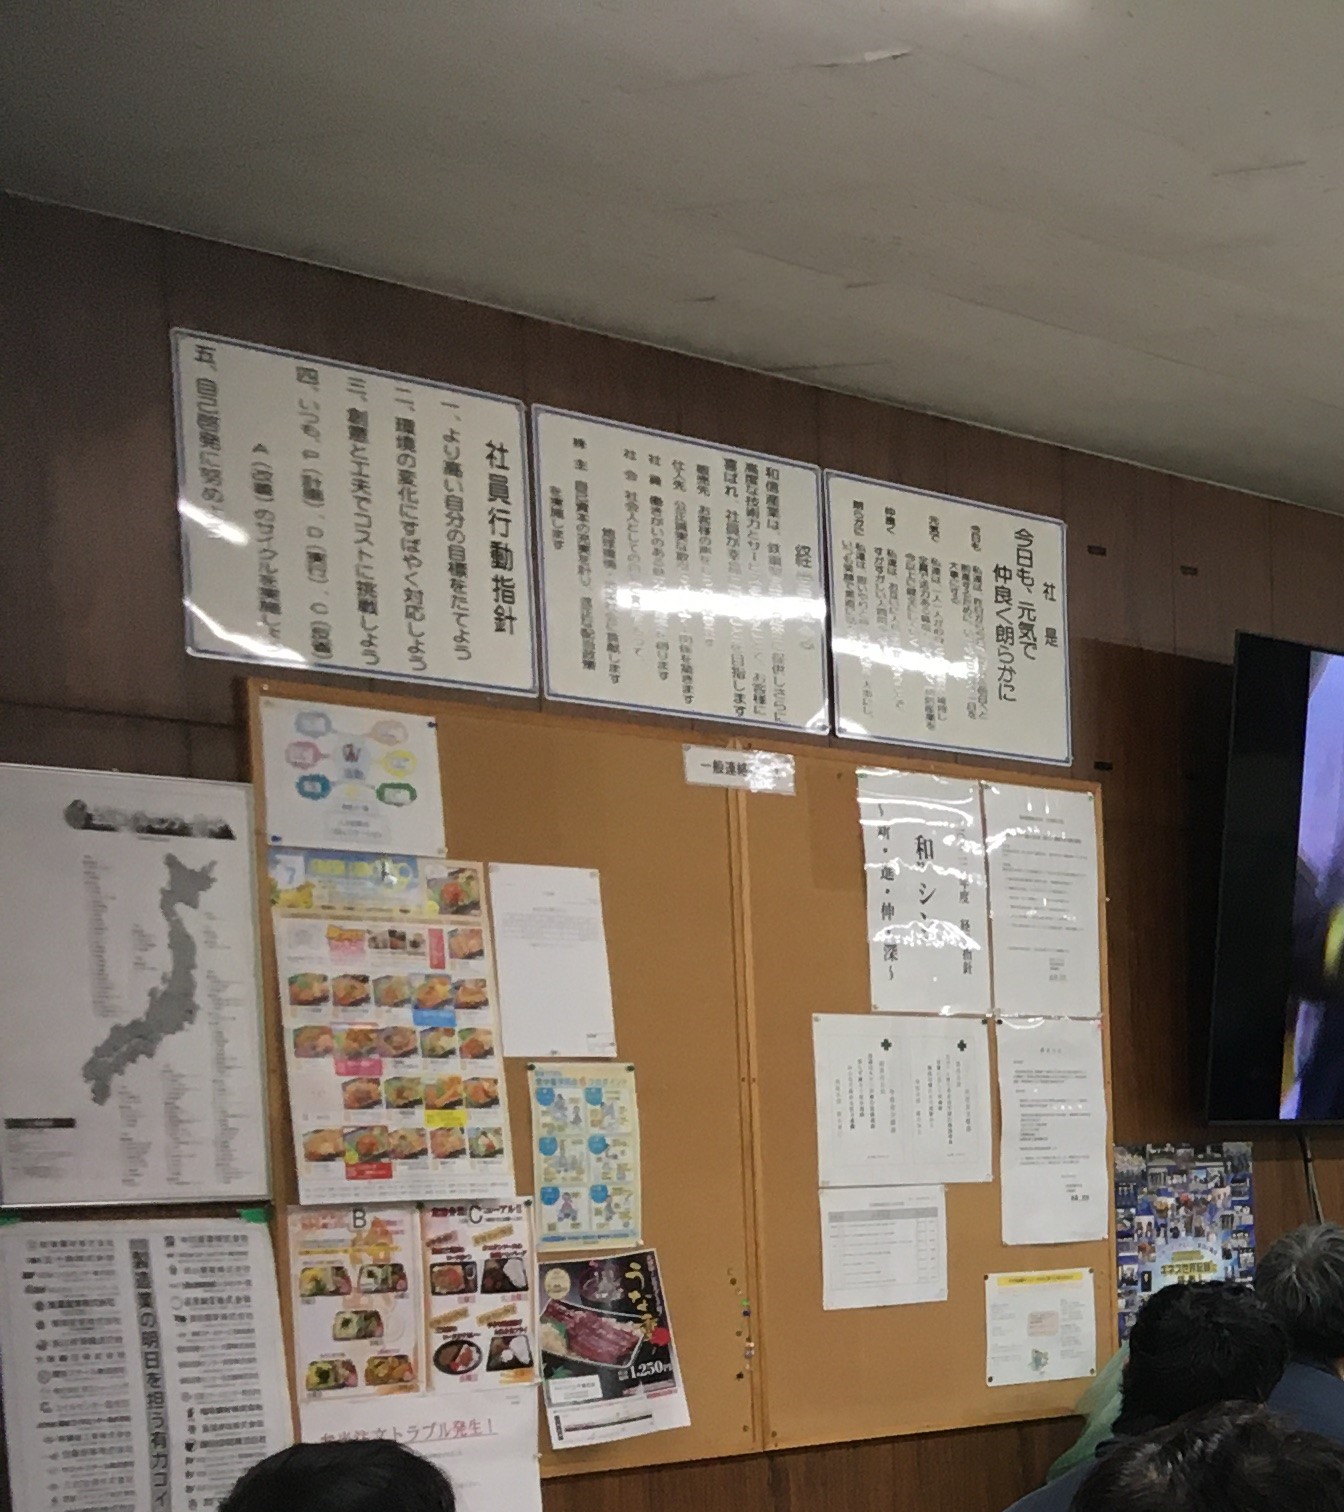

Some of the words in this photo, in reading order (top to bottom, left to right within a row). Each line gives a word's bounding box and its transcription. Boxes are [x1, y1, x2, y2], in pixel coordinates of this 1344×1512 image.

[485, 438, 518, 636] 社員行動指針
[1014, 528, 1038, 661] 今日も、元気で
[993, 563, 1017, 702] 仲良く朗らかに
[352, 1208, 367, 1229] B
[468, 1204, 483, 1224] C
